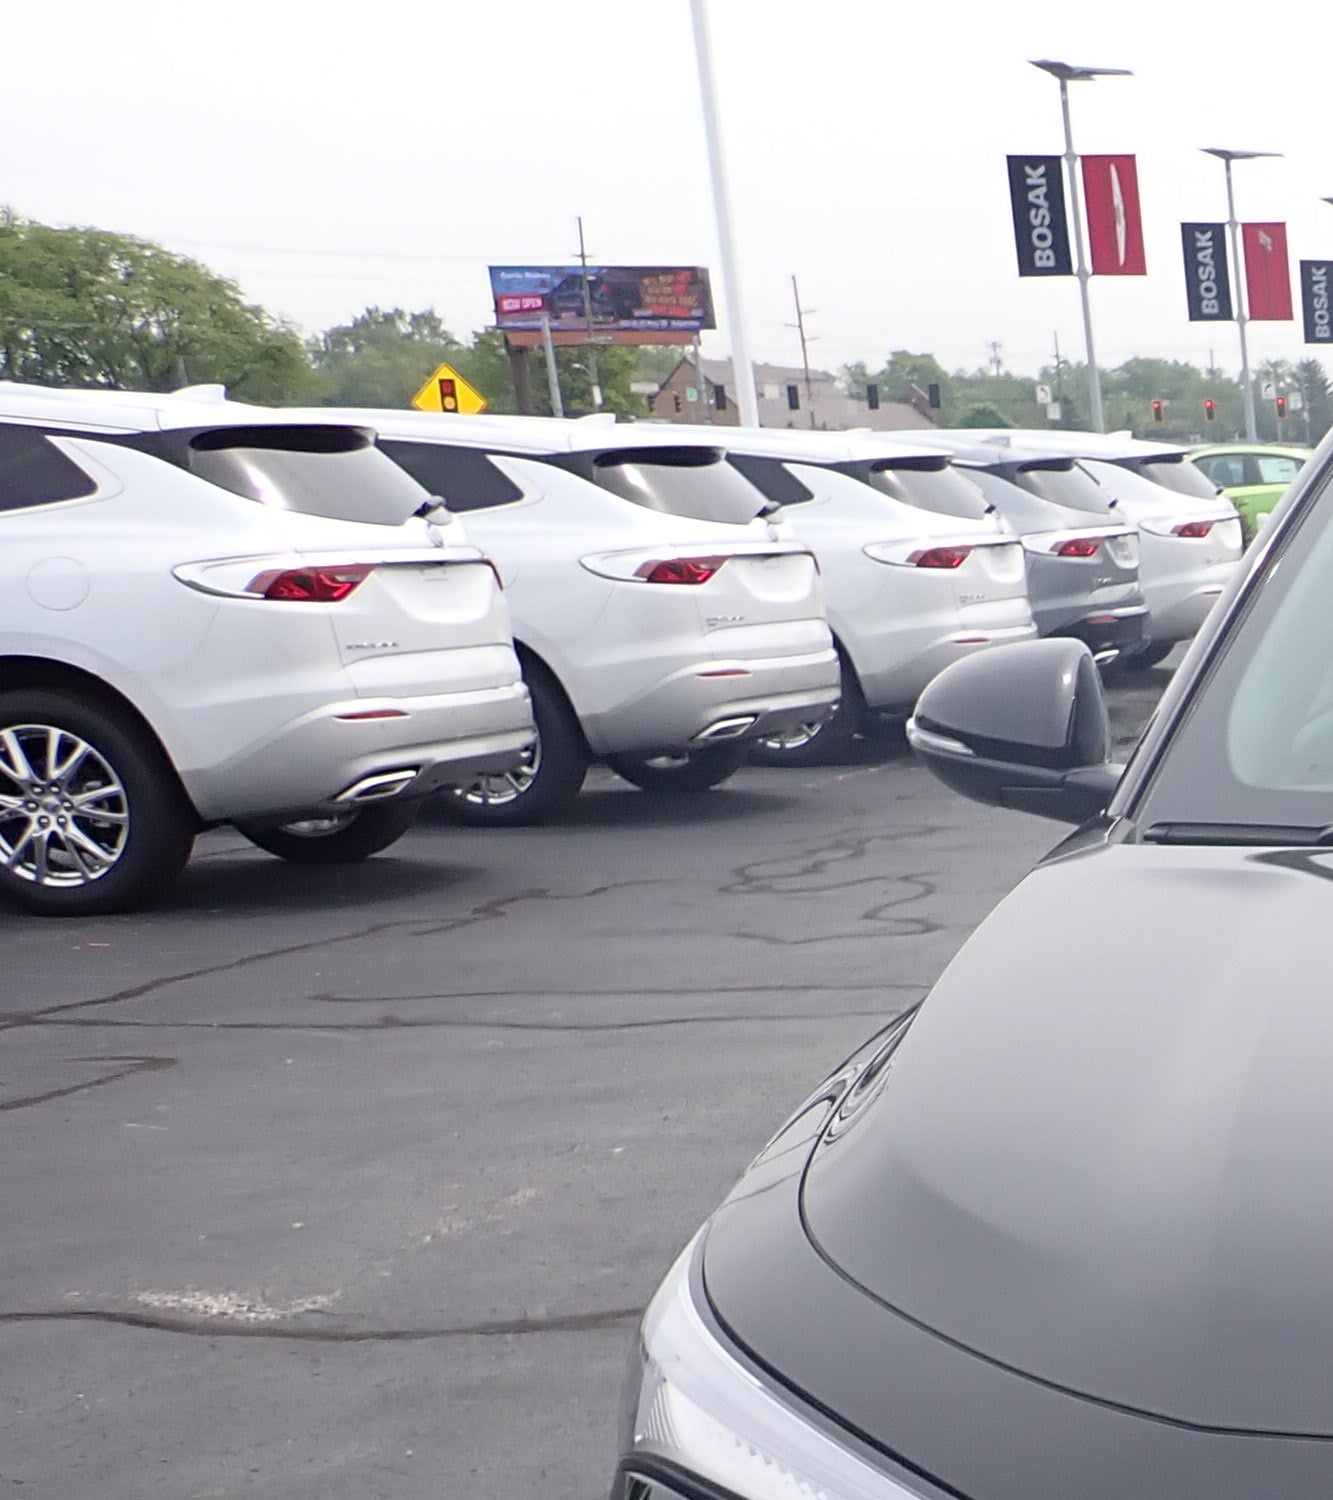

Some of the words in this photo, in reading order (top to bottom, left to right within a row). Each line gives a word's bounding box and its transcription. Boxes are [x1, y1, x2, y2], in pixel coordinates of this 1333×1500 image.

[1024, 164, 1056, 268] BOSAK
[1194, 230, 1220, 315] BOSAK
[1311, 266, 1331, 339] BOSAK
